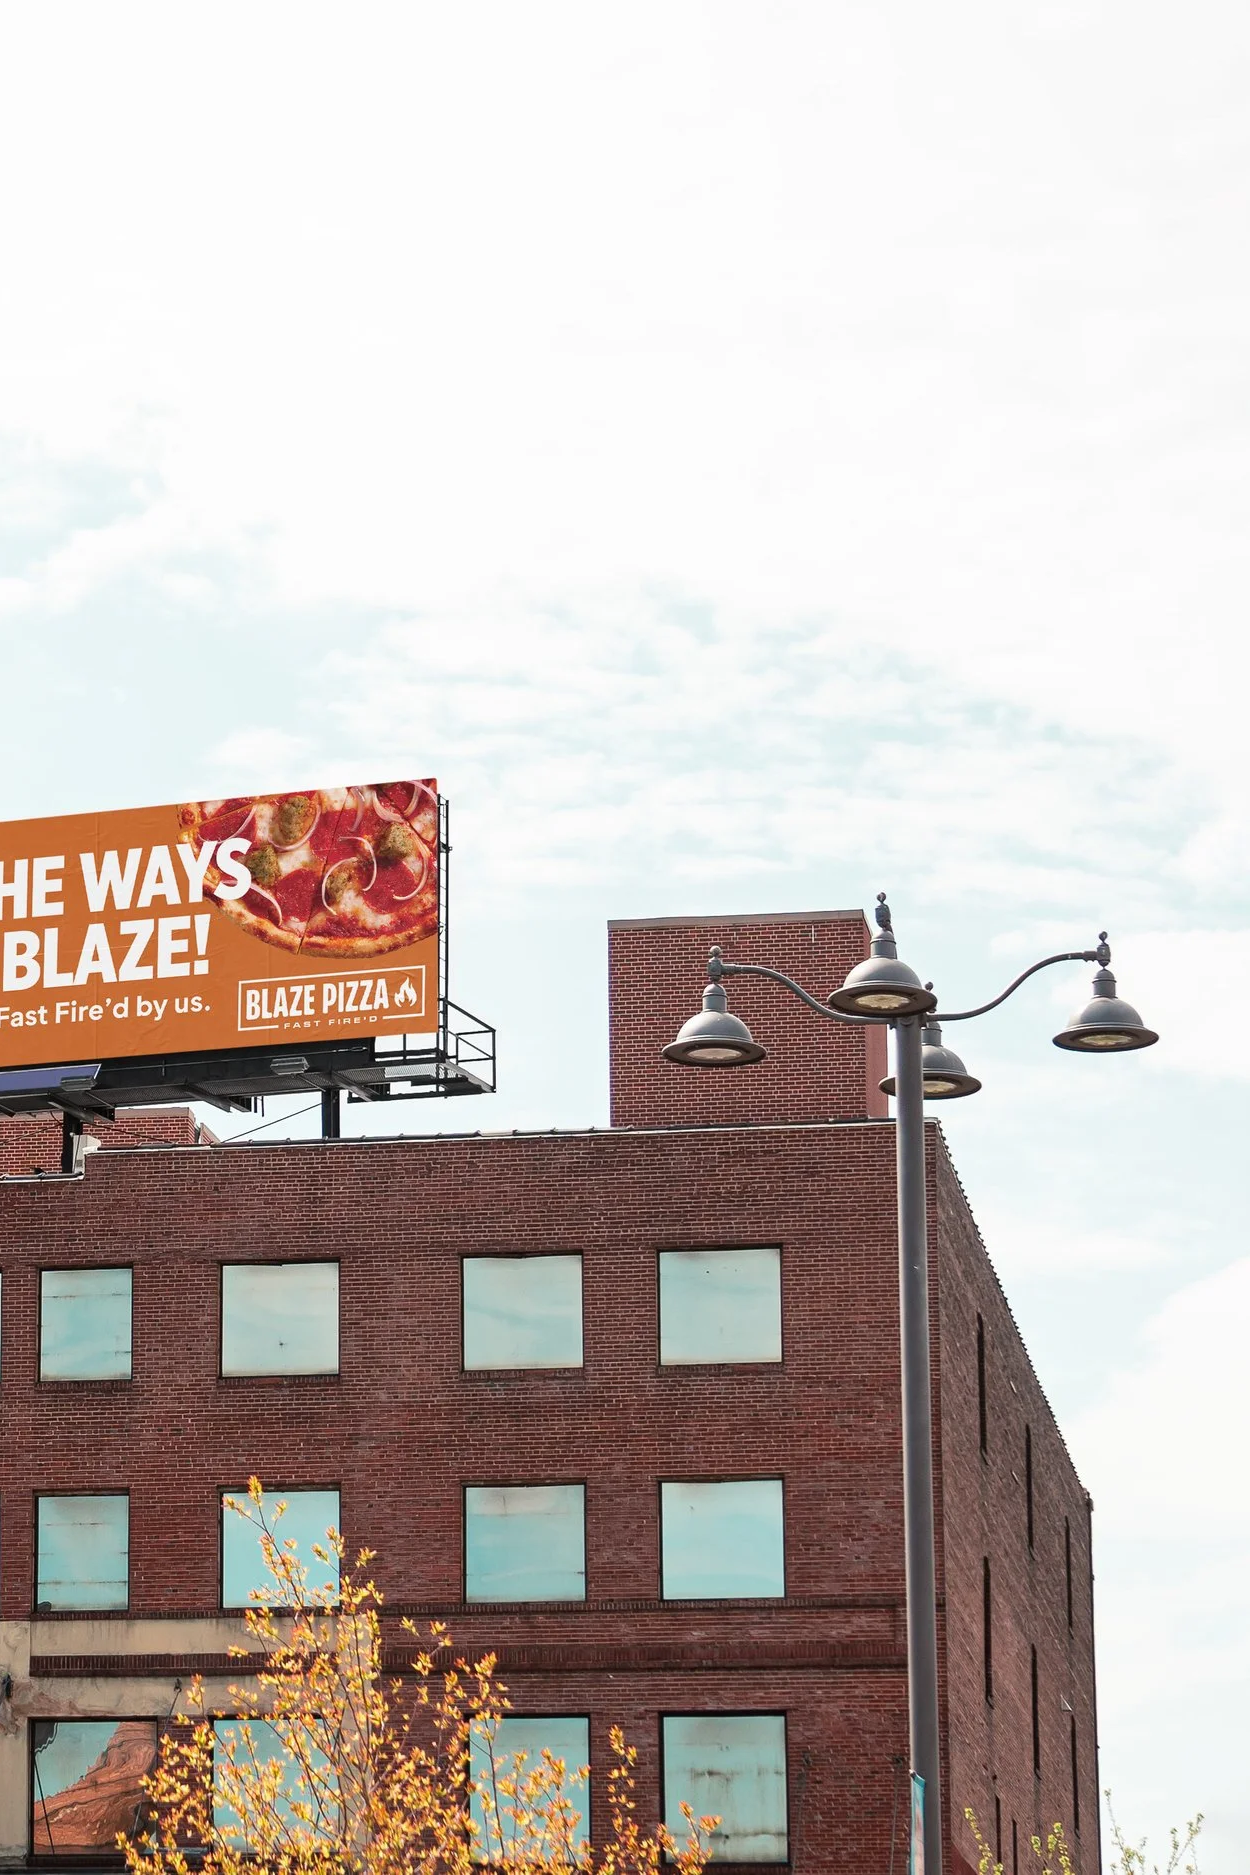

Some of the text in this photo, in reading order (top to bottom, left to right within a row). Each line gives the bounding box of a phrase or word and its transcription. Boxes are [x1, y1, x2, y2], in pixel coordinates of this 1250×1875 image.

[80, 837, 252, 912] WAYS
[3, 914, 210, 991] BLAZE!
[55, 995, 129, 1023] Fire’d
[136, 995, 168, 1021] by
[174, 996, 211, 1015] us.
[246, 978, 390, 1020] BLAZE PIZZA
[284, 1015, 378, 1030] FAST FIRE'D
